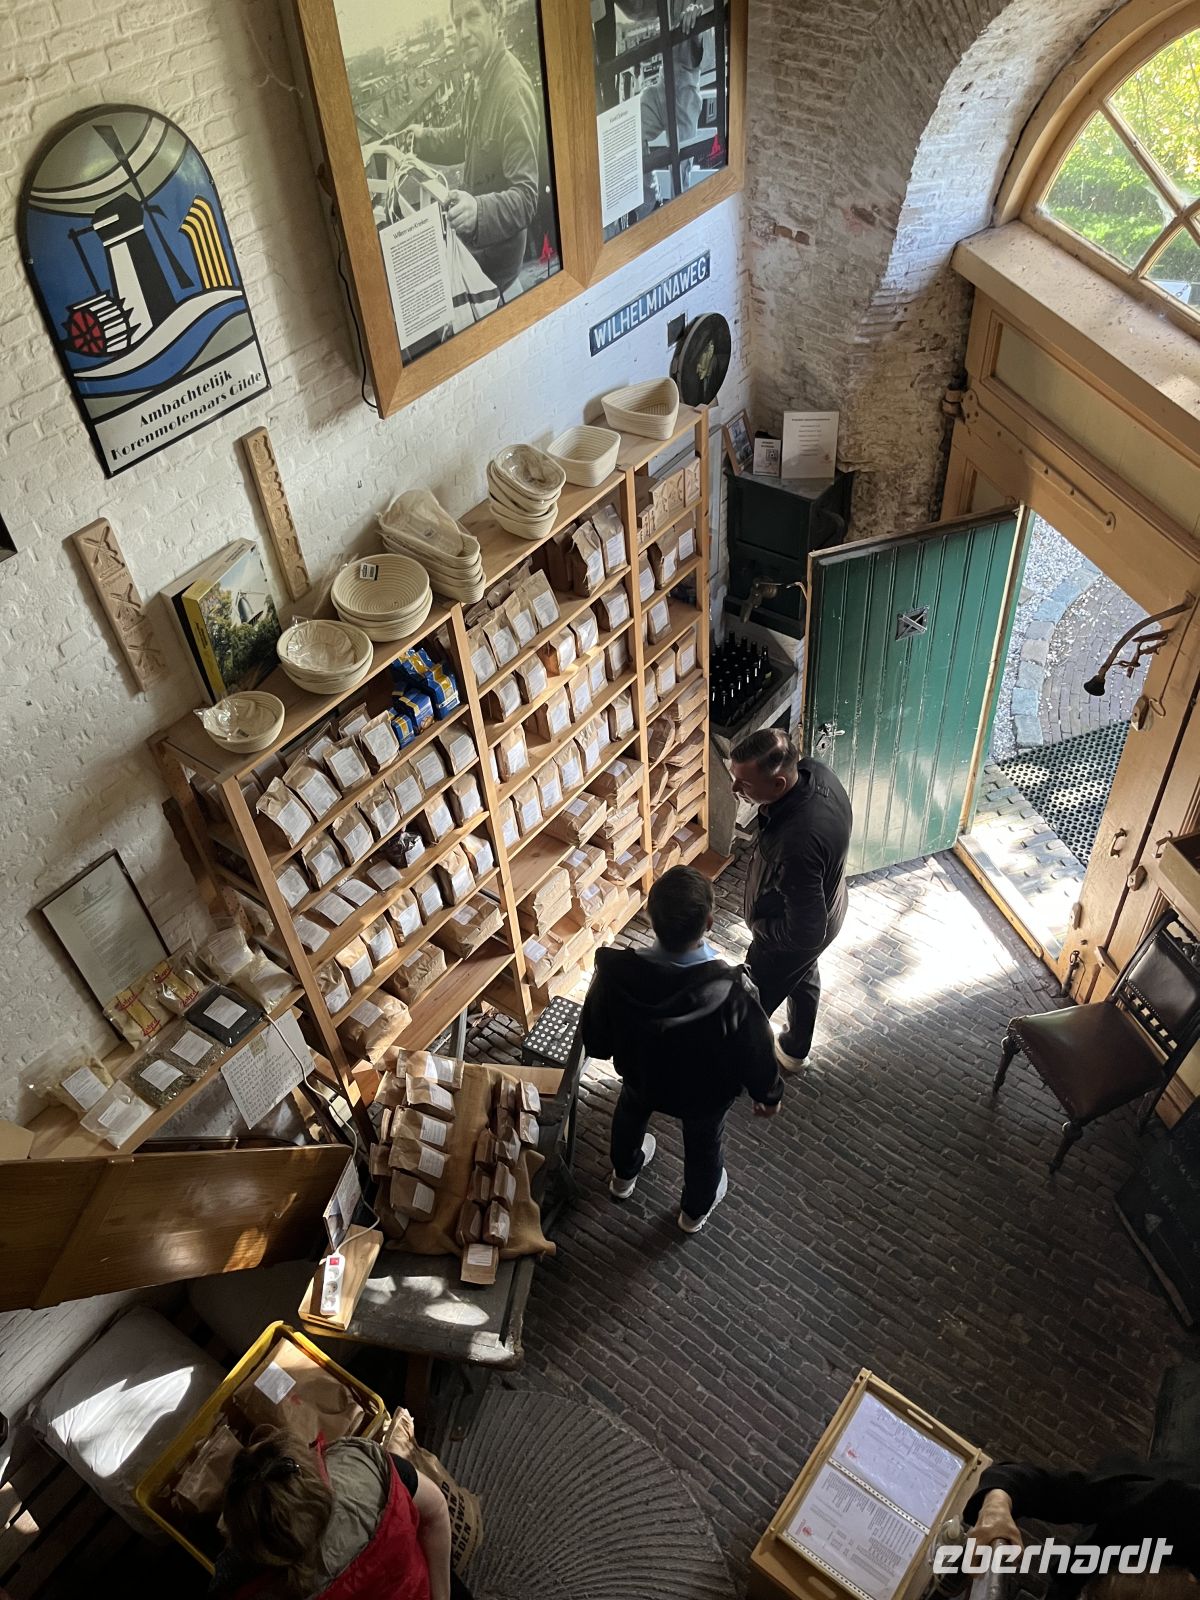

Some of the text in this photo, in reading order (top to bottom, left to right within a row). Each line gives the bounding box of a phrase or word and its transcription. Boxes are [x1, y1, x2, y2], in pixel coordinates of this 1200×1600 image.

[593, 257, 707, 350] WILHELMINAWEG
[111, 371, 262, 461] Korenmolenaars Gilde
[140, 370, 232, 427] Ambachtelijk
